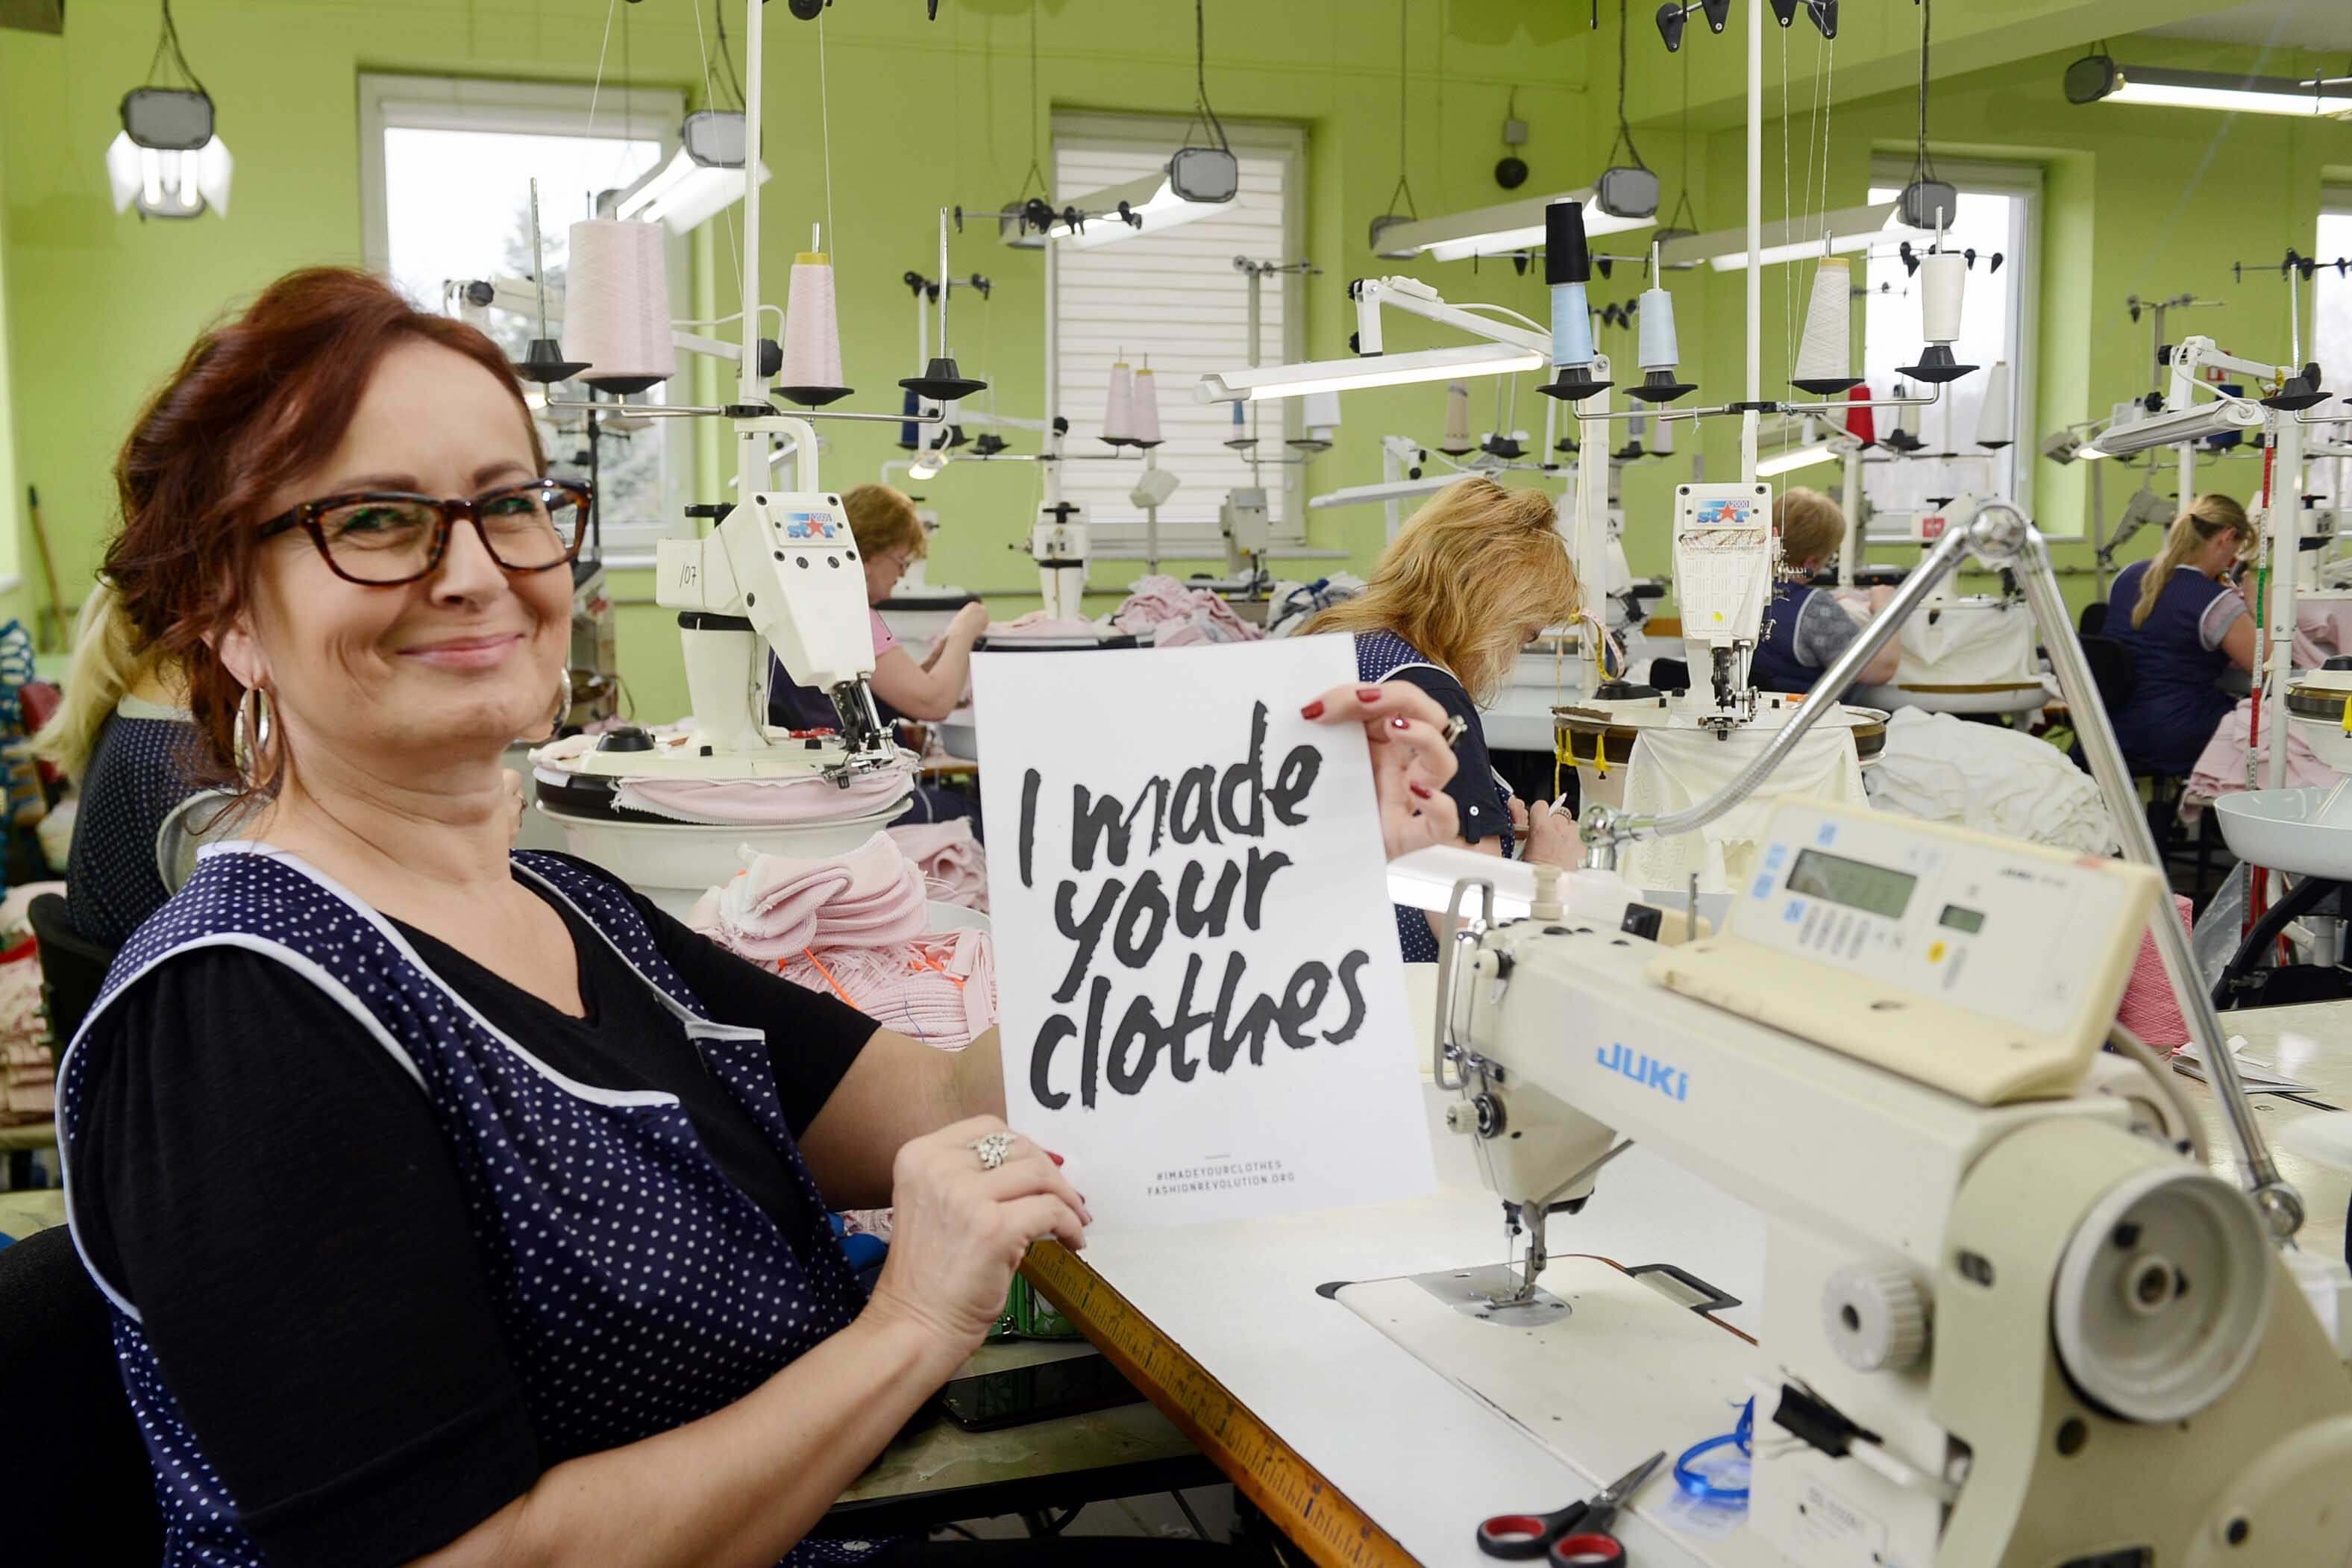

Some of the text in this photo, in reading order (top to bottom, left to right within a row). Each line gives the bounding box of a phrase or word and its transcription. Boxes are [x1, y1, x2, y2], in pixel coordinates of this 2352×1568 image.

[1019, 700, 1323, 888] I made
[1052, 846, 1293, 1003] your
[1029, 950, 1369, 1111] clothes
[1147, 1172, 1295, 1197] FASHIONREVOLUTION.ORG
[1156, 1159, 1282, 1181] #IMADEYOURCLOTHES
